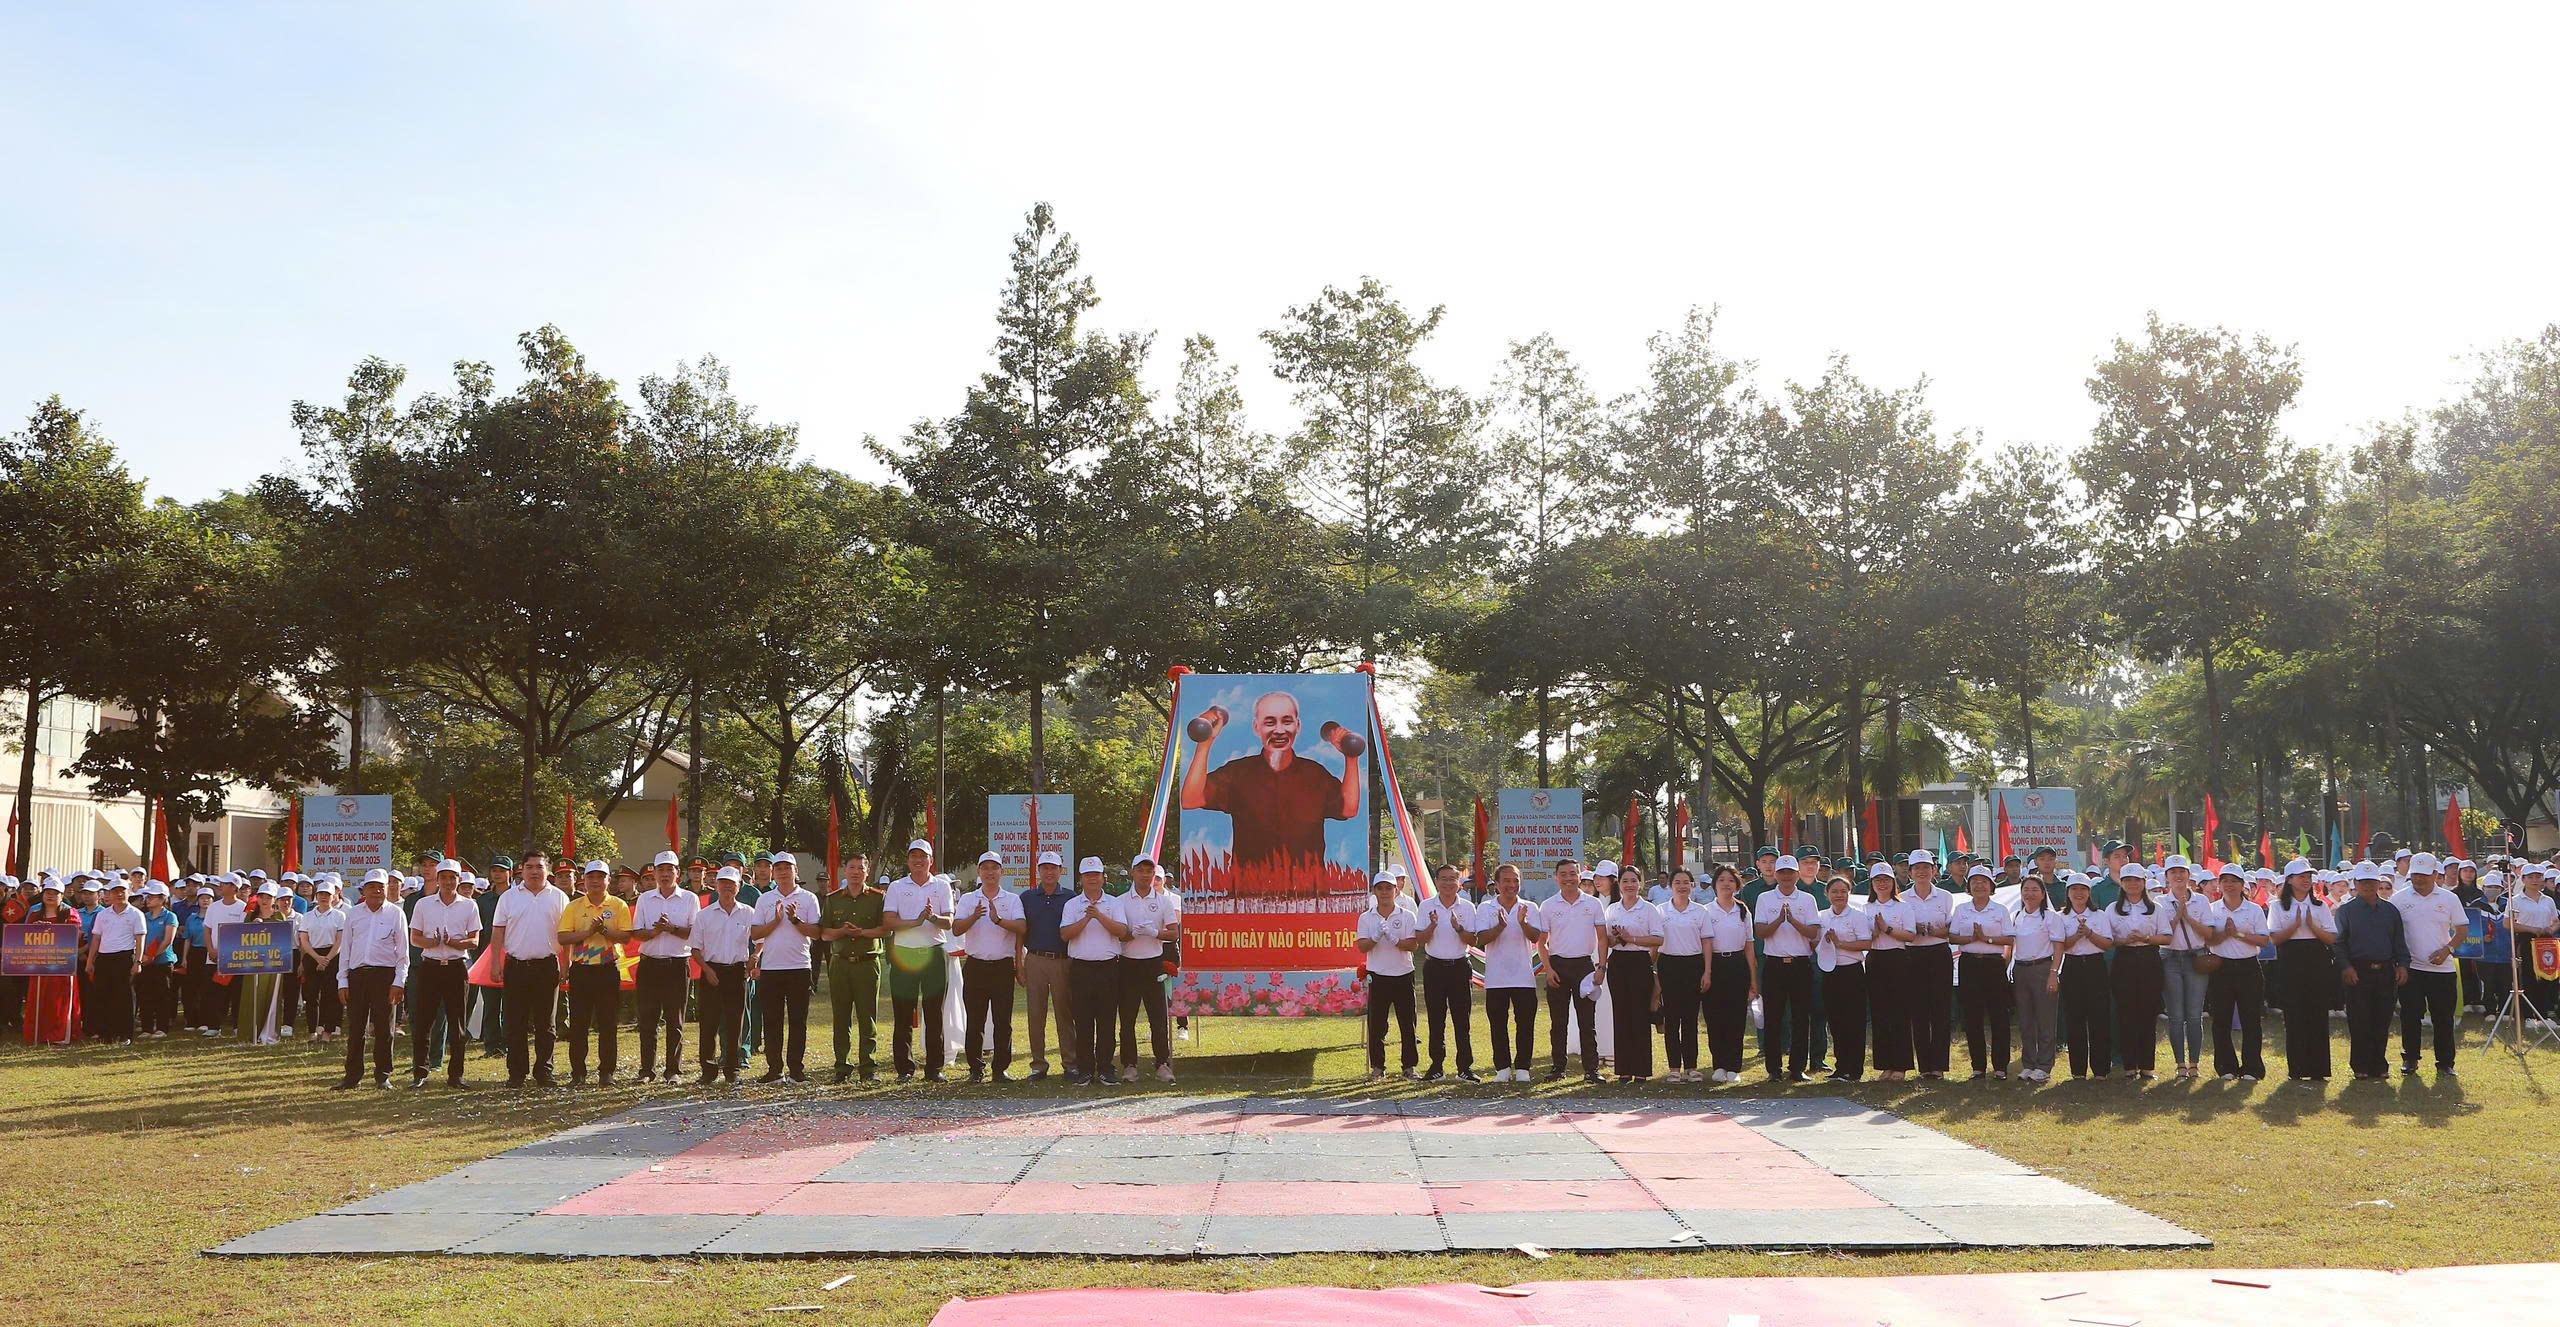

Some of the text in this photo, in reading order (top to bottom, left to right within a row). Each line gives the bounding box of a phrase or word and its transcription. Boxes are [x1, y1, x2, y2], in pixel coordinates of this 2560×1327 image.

[371, 832, 386, 840] THAO
[1054, 832, 1069, 840] THAO
[2056, 848, 2067, 856] 025
[366, 856, 380, 864] 2025
[24, 928, 55, 945] KHỐI
[240, 928, 272, 946] KHỐI
[1209, 928, 1228, 949] TÔI
[1232, 928, 1264, 949] NGÀY
[1268, 928, 1293, 949] NÀO
[1298, 928, 1331, 949] CŨNG
[1335, 928, 1358, 952] TẬP
[232, 950, 258, 961] CBCC
[268, 949, 280, 959] VC
